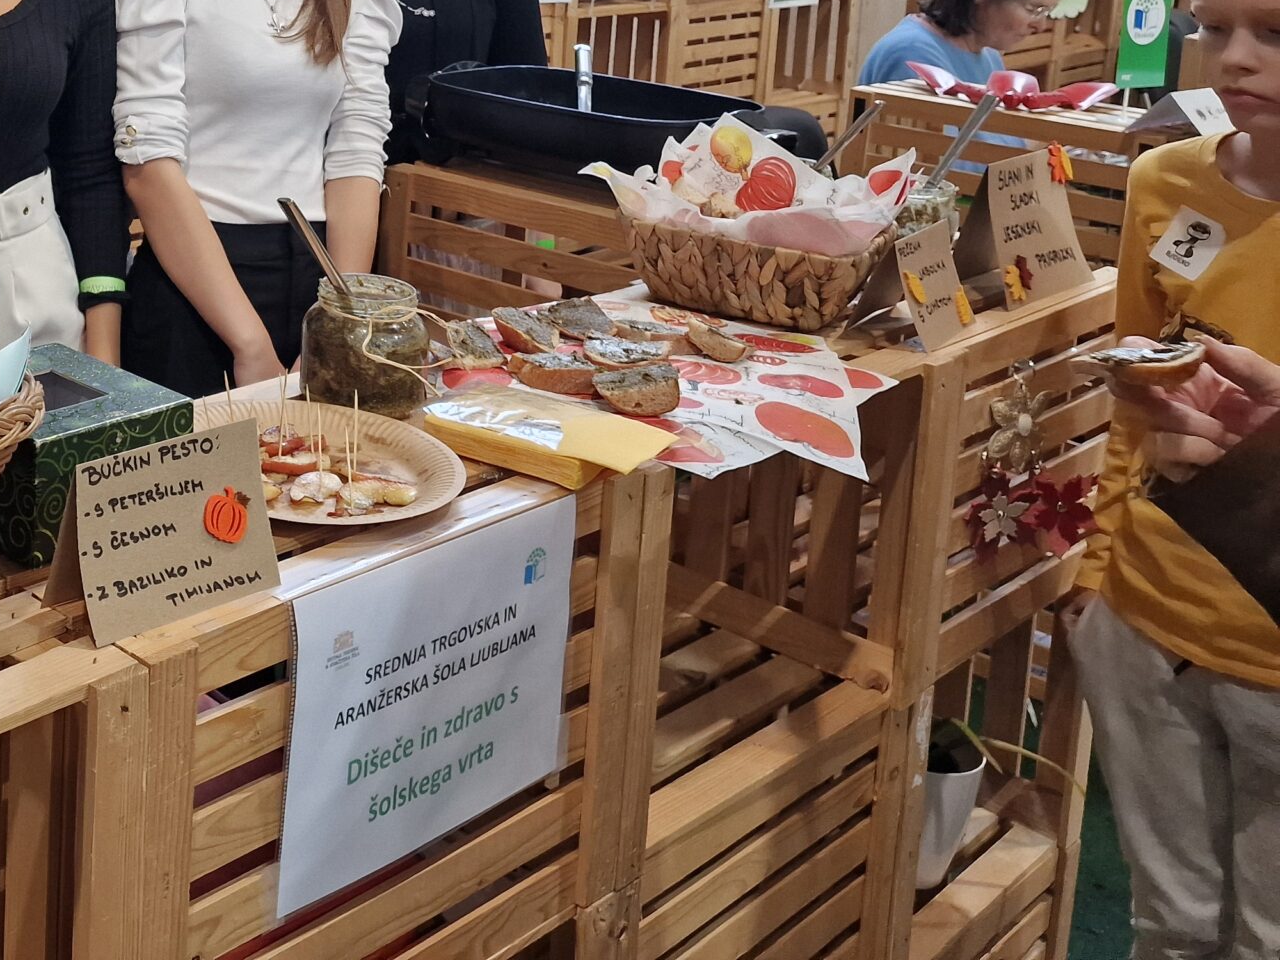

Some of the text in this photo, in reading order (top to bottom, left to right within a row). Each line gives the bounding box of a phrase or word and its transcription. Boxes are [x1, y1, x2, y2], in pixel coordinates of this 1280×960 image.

[998, 163, 1034, 191] SLANI IN
[1010, 190, 1040, 211] SLADKI
[81, 450, 151, 486] BUČKIN
[108, 479, 204, 513] PETERŠILJEM
[110, 522, 177, 551] ČESNOM
[113, 565, 188, 598] BAZILIKO
[194, 555, 213, 571] IN
[365, 644, 428, 685] SREDNJA
[431, 611, 500, 655] TRGOVSKA
[503, 603, 518, 623] IN
[334, 624, 536, 730] ARANŽERSKA ŠOLA LJUBLJANA
[347, 685, 519, 786] Dišeče in zdravo s
[368, 740, 494, 823] šolskega vrta
